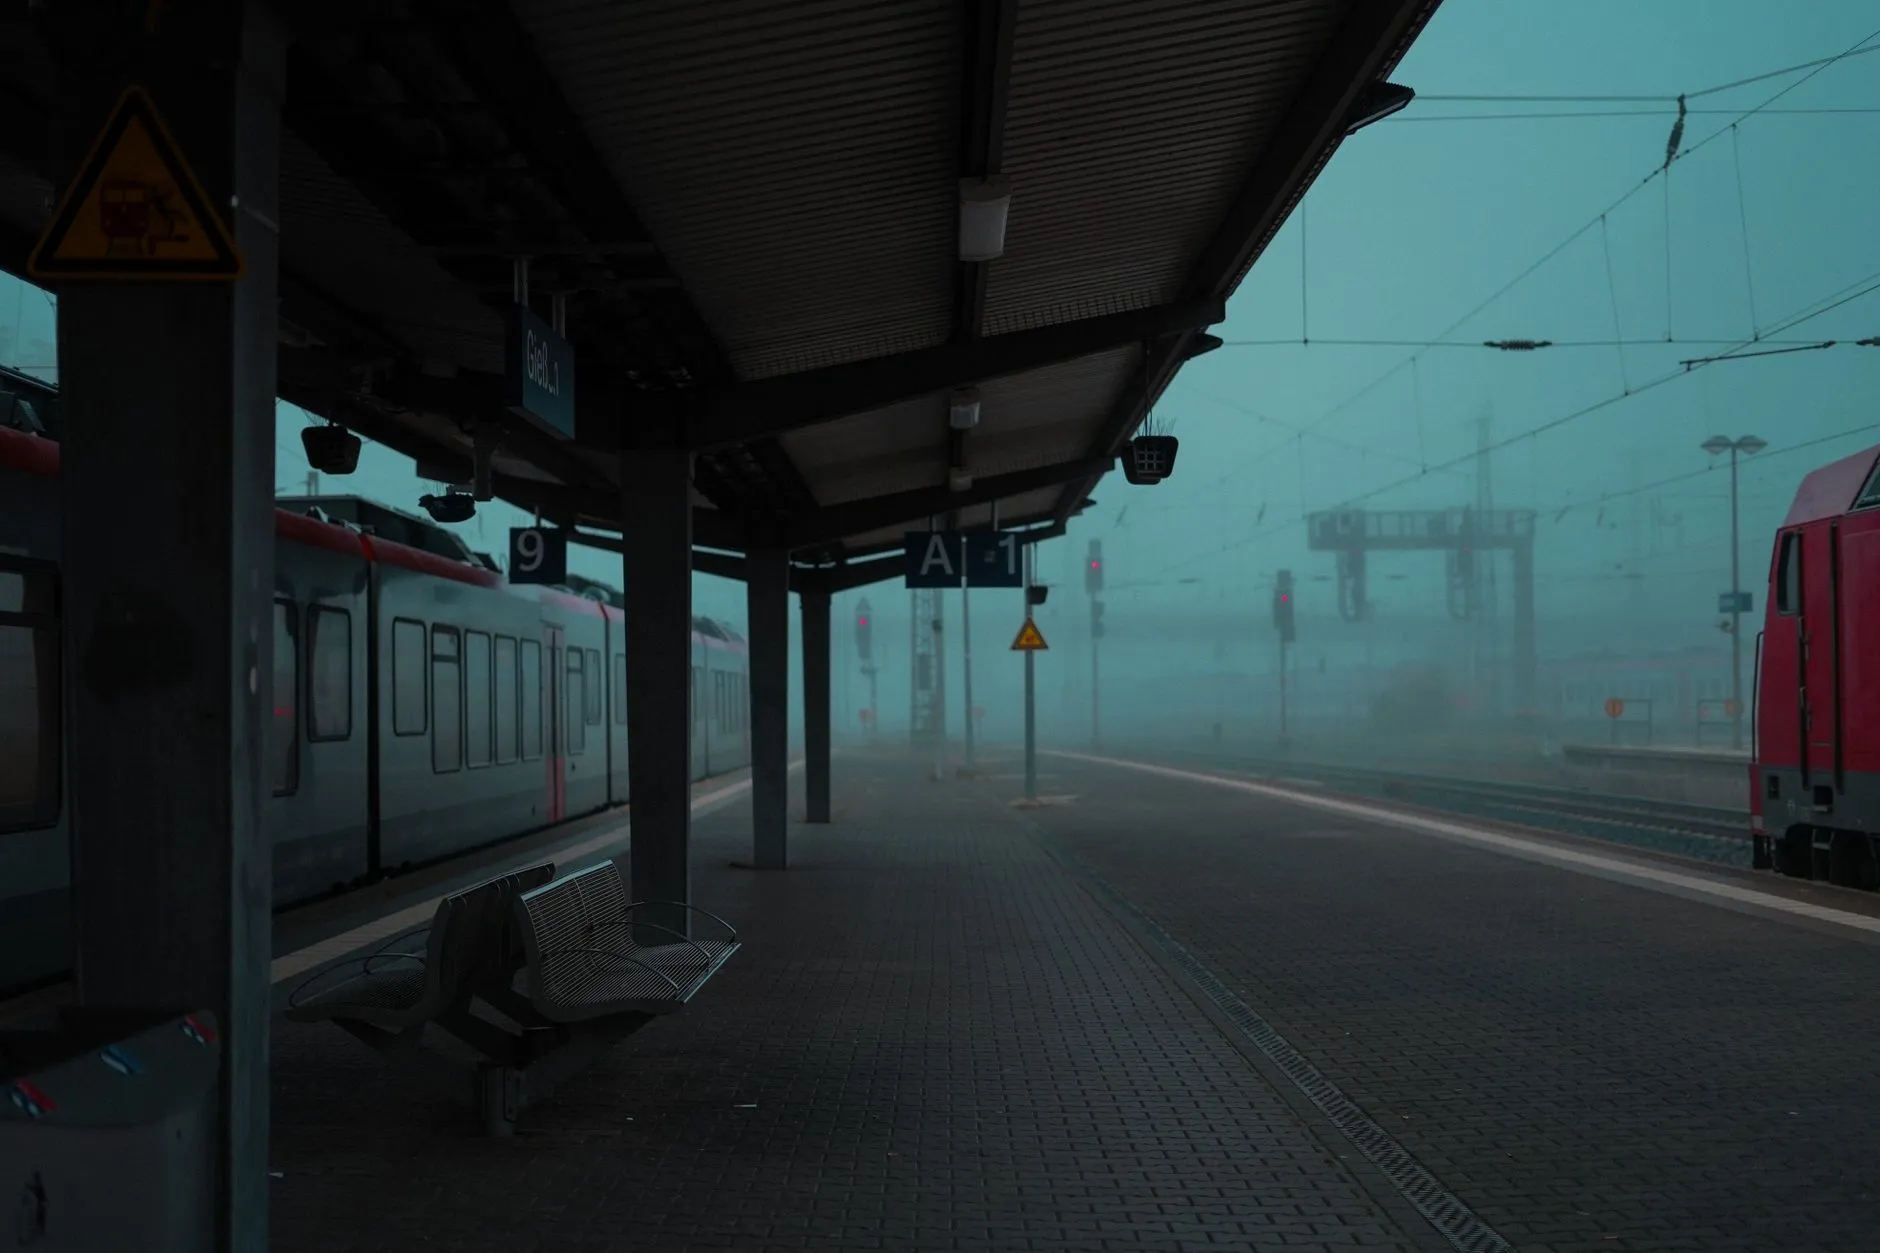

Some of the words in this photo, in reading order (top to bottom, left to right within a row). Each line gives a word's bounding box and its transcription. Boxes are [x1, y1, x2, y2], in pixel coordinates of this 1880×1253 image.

[527, 329, 559, 397] Gießn
[517, 529, 545, 572] 9
[919, 533, 954, 576] A
[998, 533, 1016, 576] 1
